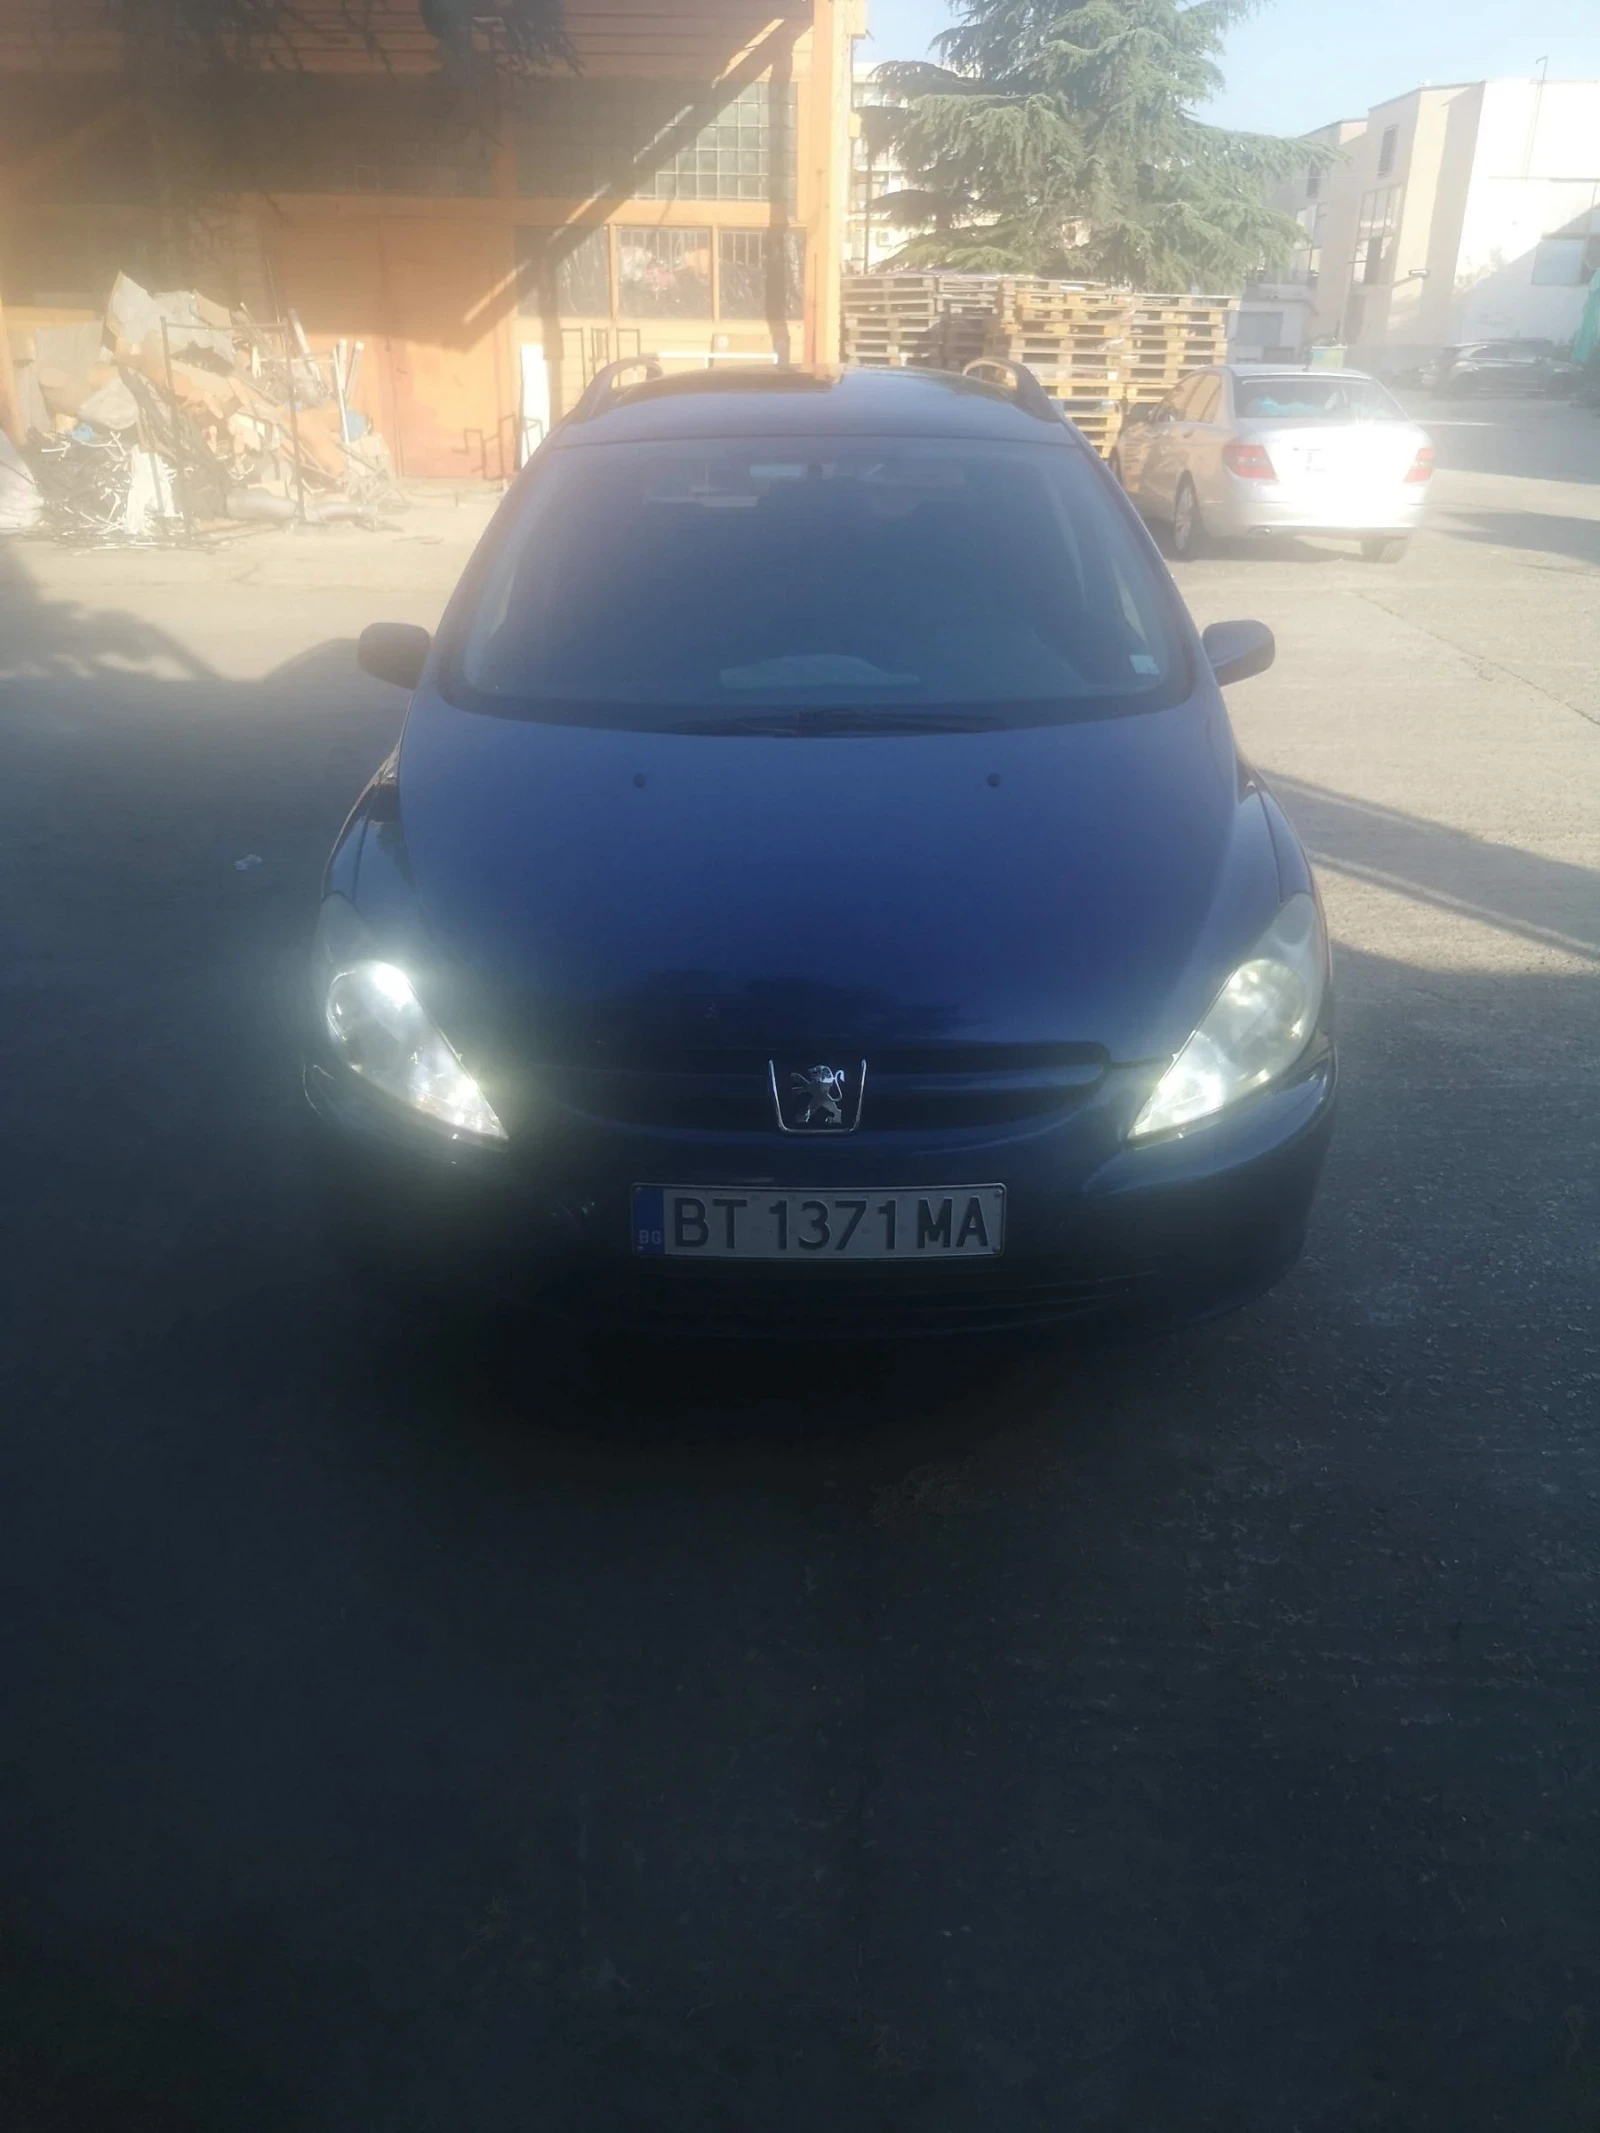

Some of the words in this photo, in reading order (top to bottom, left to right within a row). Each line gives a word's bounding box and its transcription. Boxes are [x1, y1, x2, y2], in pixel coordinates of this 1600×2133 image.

[639, 1230, 662, 1245] BG
[674, 1197, 748, 1249] BT
[768, 1198, 898, 1250] 1371
[916, 1196, 989, 1249] MA
